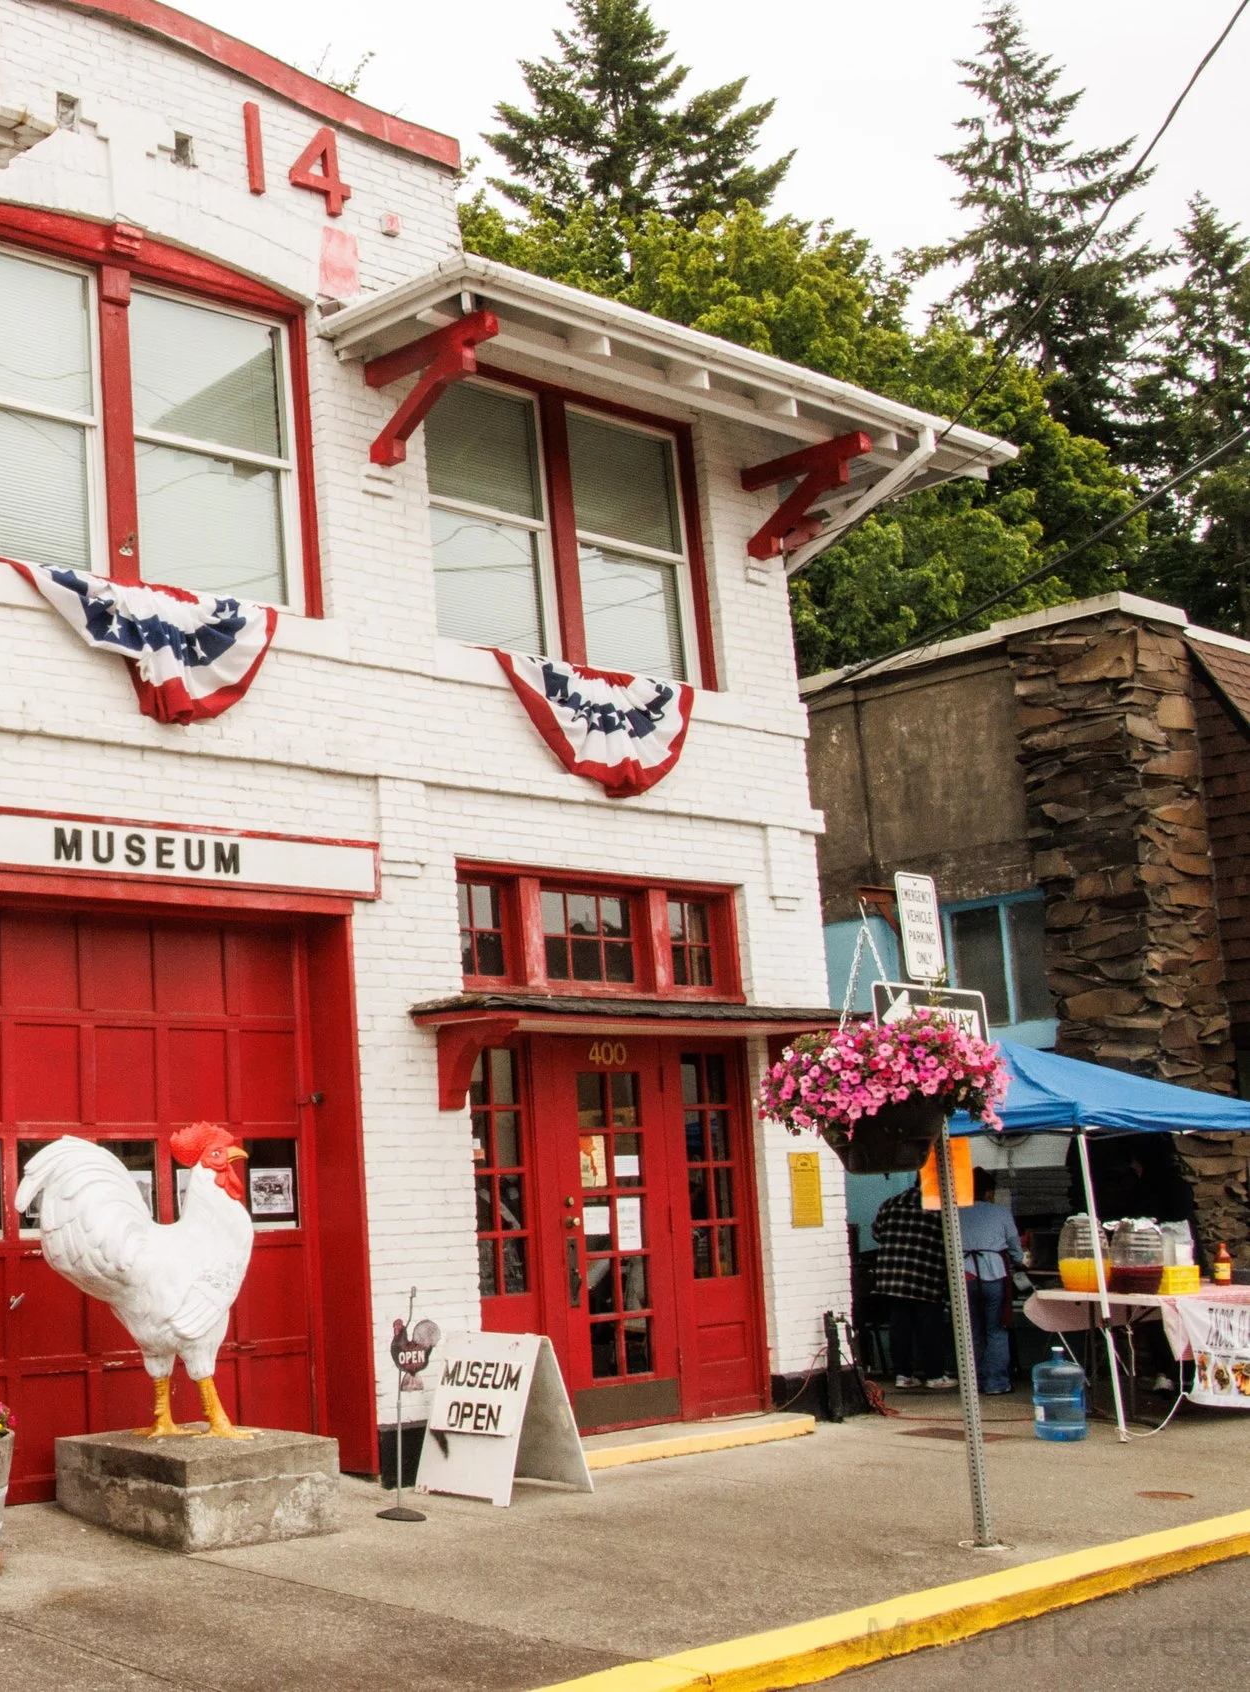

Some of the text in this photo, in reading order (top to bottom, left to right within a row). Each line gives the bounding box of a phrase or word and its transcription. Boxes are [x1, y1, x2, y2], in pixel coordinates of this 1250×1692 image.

[53, 826, 241, 875] MUSEUM
[906, 908, 933, 925] VEHICLE
[908, 928, 937, 945] PARKING
[916, 951, 933, 965] ONLY
[588, 1041, 628, 1066] 400
[398, 1350, 426, 1365] OPEN
[440, 1359, 523, 1392] MUSEUM
[447, 1401, 502, 1431] OPEN
